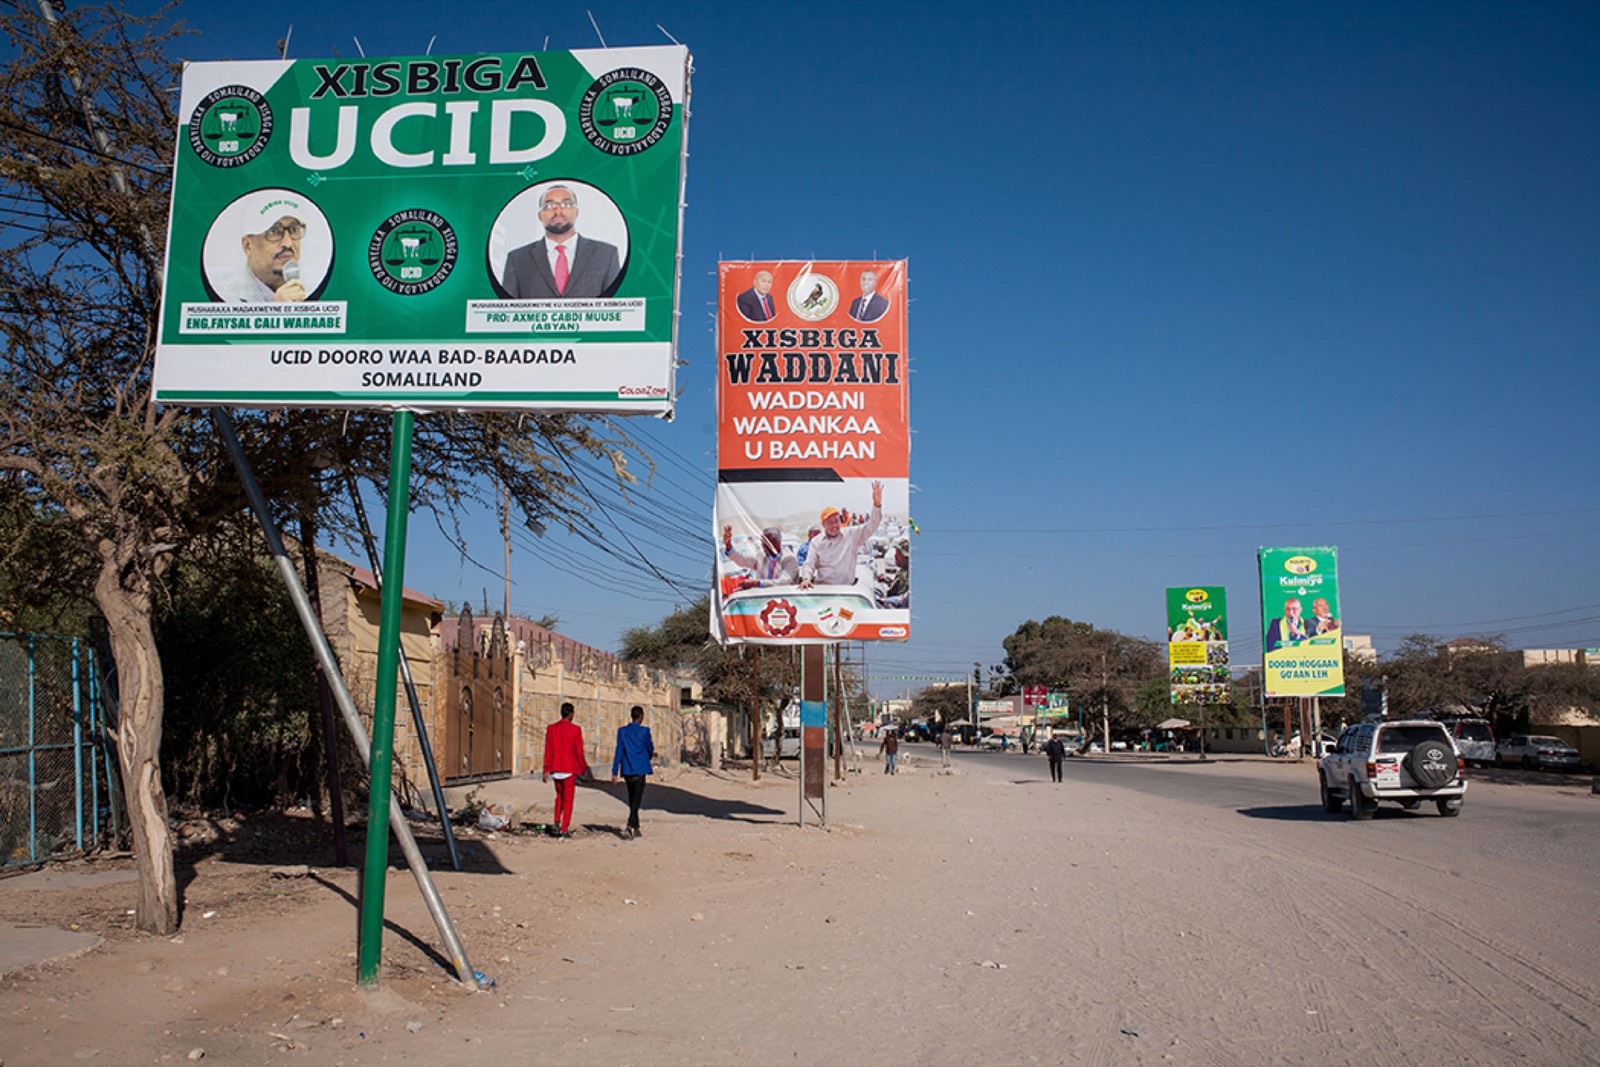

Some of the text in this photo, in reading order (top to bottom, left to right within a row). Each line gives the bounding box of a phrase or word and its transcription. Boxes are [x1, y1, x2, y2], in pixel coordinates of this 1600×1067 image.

[310, 56, 548, 98] XISBIGA
[600, 69, 657, 87] SOMALILAND
[208, 87, 260, 102] SOMALILAND
[289, 98, 567, 170] UCID
[613, 127, 635, 139] UCID
[388, 211, 444, 227] SOMALILAND
[254, 317, 280, 329] CALI
[283, 317, 341, 329] WARAABE
[487, 312, 621, 323] PRO: AXMED CABDI MUUSE
[531, 323, 580, 332] (ABYAN)
[741, 328, 882, 349] XISBIGA
[271, 350, 312, 364] UCID
[318, 350, 383, 364] DOORO
[388, 349, 432, 364] WAA
[438, 349, 576, 364] BAD-BAADADA
[724, 352, 900, 385] WADDANI
[362, 372, 482, 387] SOMALILAND
[747, 391, 865, 410] WADDANI
[733, 416, 881, 435] WADANKAA
[744, 440, 876, 459] U BAAHAN
[1268, 660, 1339, 669] DOORO HOGGAAN
[1312, 670, 1328, 678] LEH
